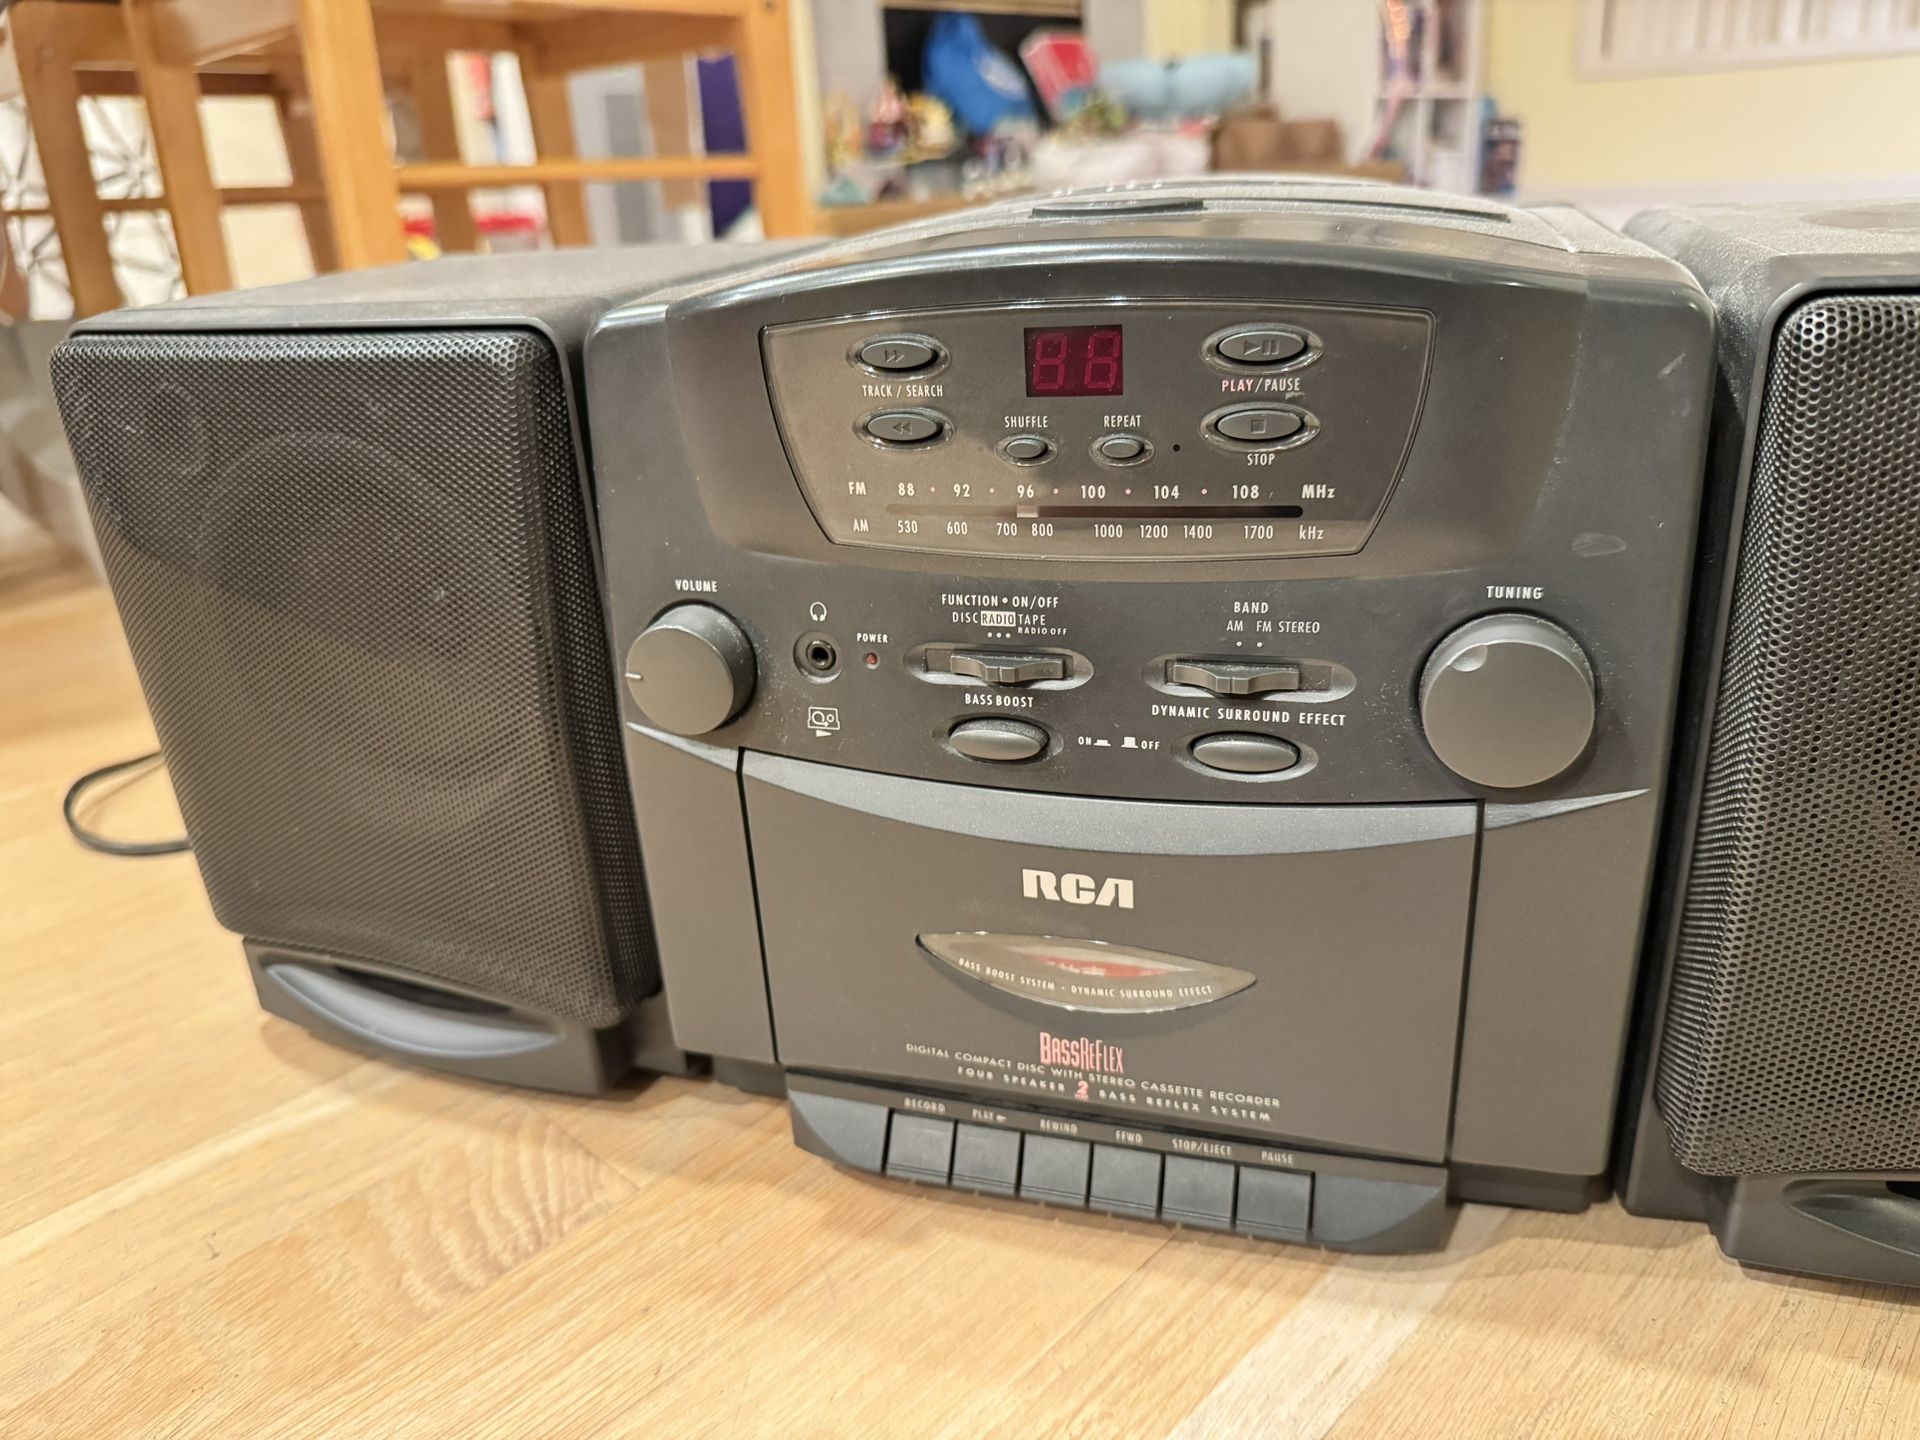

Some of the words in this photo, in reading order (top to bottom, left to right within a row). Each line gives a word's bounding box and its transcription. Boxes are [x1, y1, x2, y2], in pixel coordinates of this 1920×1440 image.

[862, 385, 893, 398] TRACK
[906, 384, 944, 398] SEARCH
[1004, 416, 1049, 429] SHUFFLE
[1103, 415, 1142, 428] REPEAT
[1247, 454, 1275, 467] STOP
[848, 482, 867, 496] FM
[898, 484, 915, 497] 88
[953, 484, 971, 498] 92
[1017, 485, 1035, 498] 96
[1080, 485, 1107, 499] 100
[1153, 486, 1180, 500] 104
[1232, 486, 1260, 500] 108
[1301, 484, 1336, 499] MHz
[853, 520, 870, 533] AM
[897, 521, 919, 535] 530
[946, 522, 968, 536] 600
[996, 523, 1018, 537] 700
[1031, 523, 1054, 538] 800
[1093, 524, 1124, 539] 1000
[1140, 525, 1169, 539] 1200
[1183, 525, 1213, 540] 1400
[1244, 525, 1274, 540] 1700
[1299, 525, 1324, 541] kHz
[675, 579, 718, 593] VOLUME
[1486, 585, 1544, 600] TUNING
[941, 593, 999, 607] FUNCTION
[1012, 596, 1059, 609] ON/OFF
[1233, 602, 1269, 614] BAND
[952, 611, 979, 624] DISC
[981, 612, 1016, 627] RADIO
[1018, 613, 1046, 626] TAPE
[1017, 626, 1048, 635] RADIO
[1050, 627, 1068, 636] OFF
[1226, 620, 1244, 632] AM
[1256, 621, 1272, 633] FM
[1278, 621, 1321, 634] STEREO
[856, 632, 889, 644] POWER
[964, 693, 993, 706] BASS
[995, 694, 1035, 708] BOOST
[1151, 704, 1210, 719] DYNAMIC
[1217, 708, 1291, 723] SURROUND
[1298, 712, 1347, 726] EFFECT
[1078, 736, 1092, 746] ON
[1141, 740, 1161, 751] OFF
[1022, 868, 1135, 910] RCA
[958, 957, 981, 973] BASS
[985, 966, 1016, 983] BOOST
[1019, 975, 1056, 991] SYSTEM
[1071, 984, 1115, 998] DYNAMIC
[1119, 987, 1174, 999] SURROUND
[1178, 984, 1213, 997] EFFECT
[905, 1042, 950, 1059] DIGITAL
[954, 1051, 1012, 1069] COMPACT
[1017, 1062, 1046, 1074] DISC
[1050, 1066, 1083, 1080] WITH
[1087, 1072, 1136, 1087] STEREO
[1140, 1080, 1204, 1098] CASSETTE
[1209, 1089, 1281, 1108] RECORDER
[956, 1066, 995, 1080] FOUR
[1003, 1073, 1066, 1092] SPEAKER
[1077, 1080, 1089, 1095] 2
[1099, 1089, 1137, 1103] BASS
[1146, 1096, 1200, 1113] REFLEX
[1210, 1105, 1272, 1122] SYSTEM
[903, 1097, 947, 1115] RECORD
[971, 1108, 996, 1121] PLAY
[1039, 1118, 1079, 1134] REWIND
[1115, 1129, 1144, 1145] FFWD
[1172, 1138, 1232, 1156] STOP/EJECT
[1261, 1150, 1295, 1165] PAUSE
